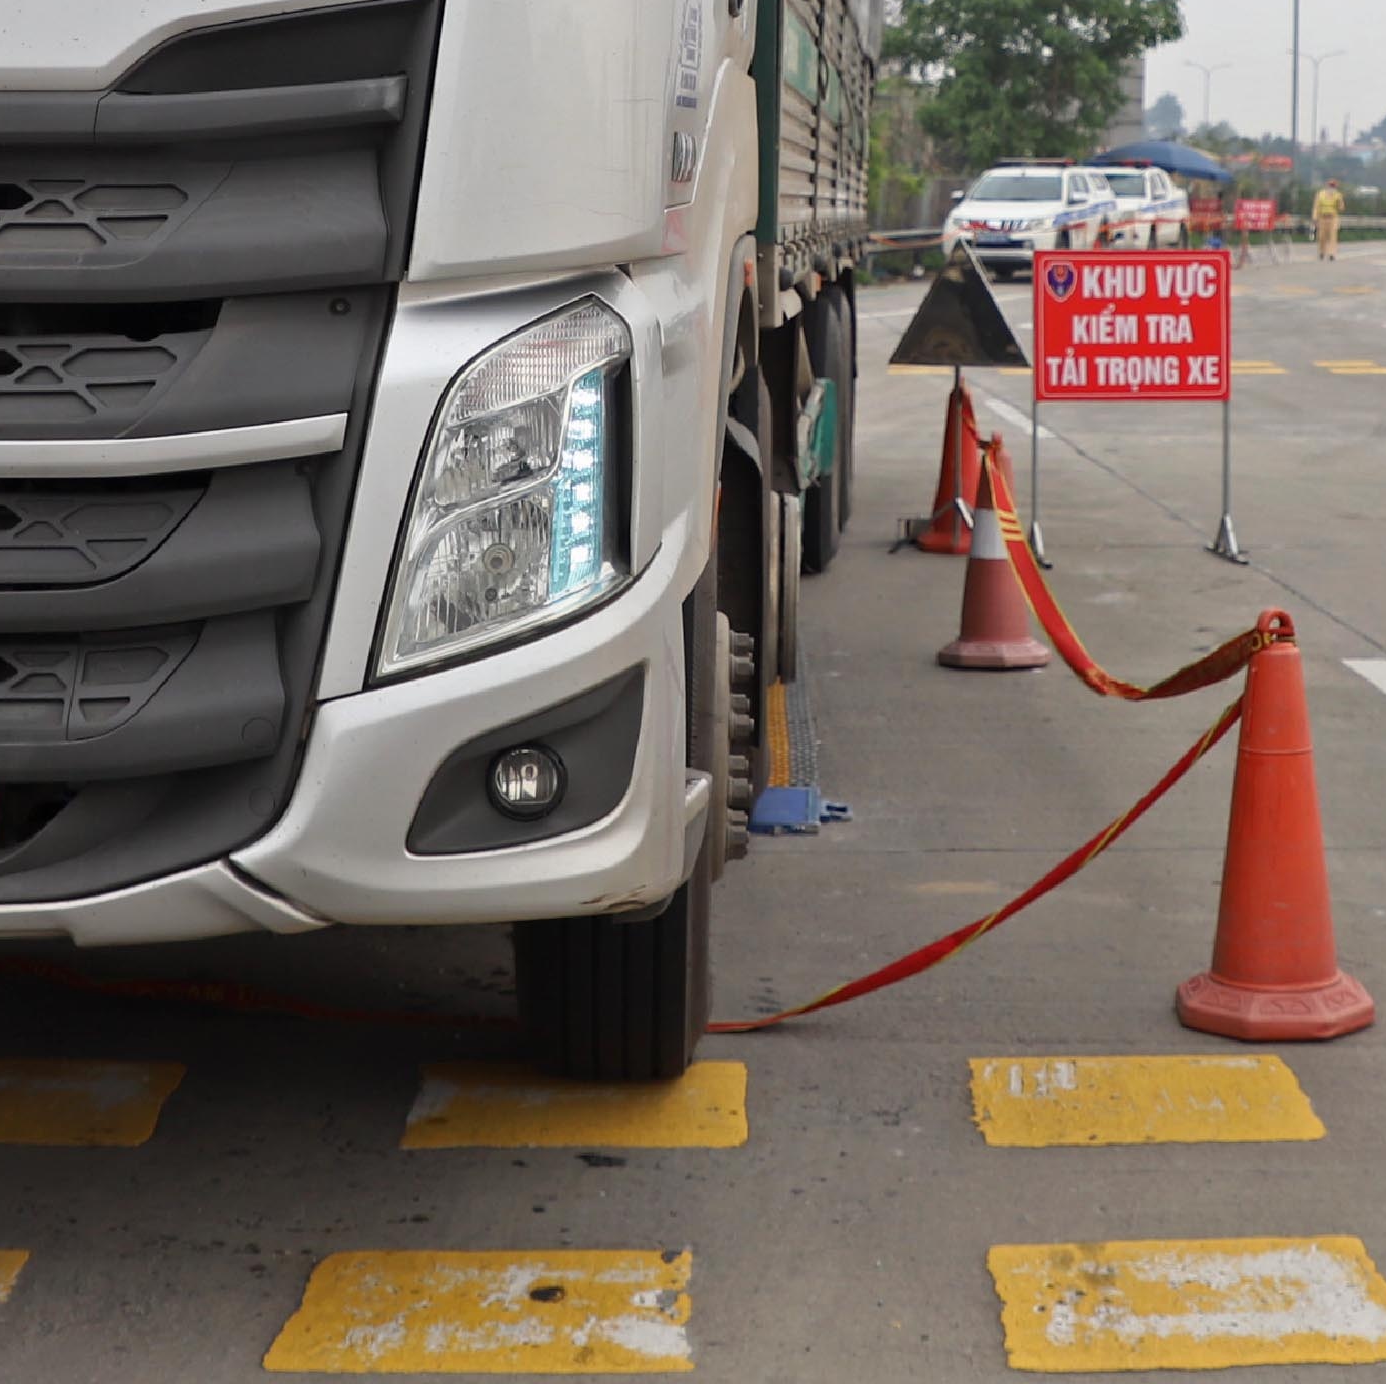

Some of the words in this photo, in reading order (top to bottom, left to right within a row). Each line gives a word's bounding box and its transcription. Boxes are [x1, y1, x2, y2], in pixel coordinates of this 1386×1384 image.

[1082, 264, 1147, 299] KHU
[1154, 261, 1217, 306] VỰC
[1072, 302, 1139, 345] KIỂM
[1144, 314, 1194, 344] TRA
[1045, 347, 1088, 387] TẢI
[1094, 354, 1181, 393] TRỌNG
[1186, 354, 1221, 386] XE
